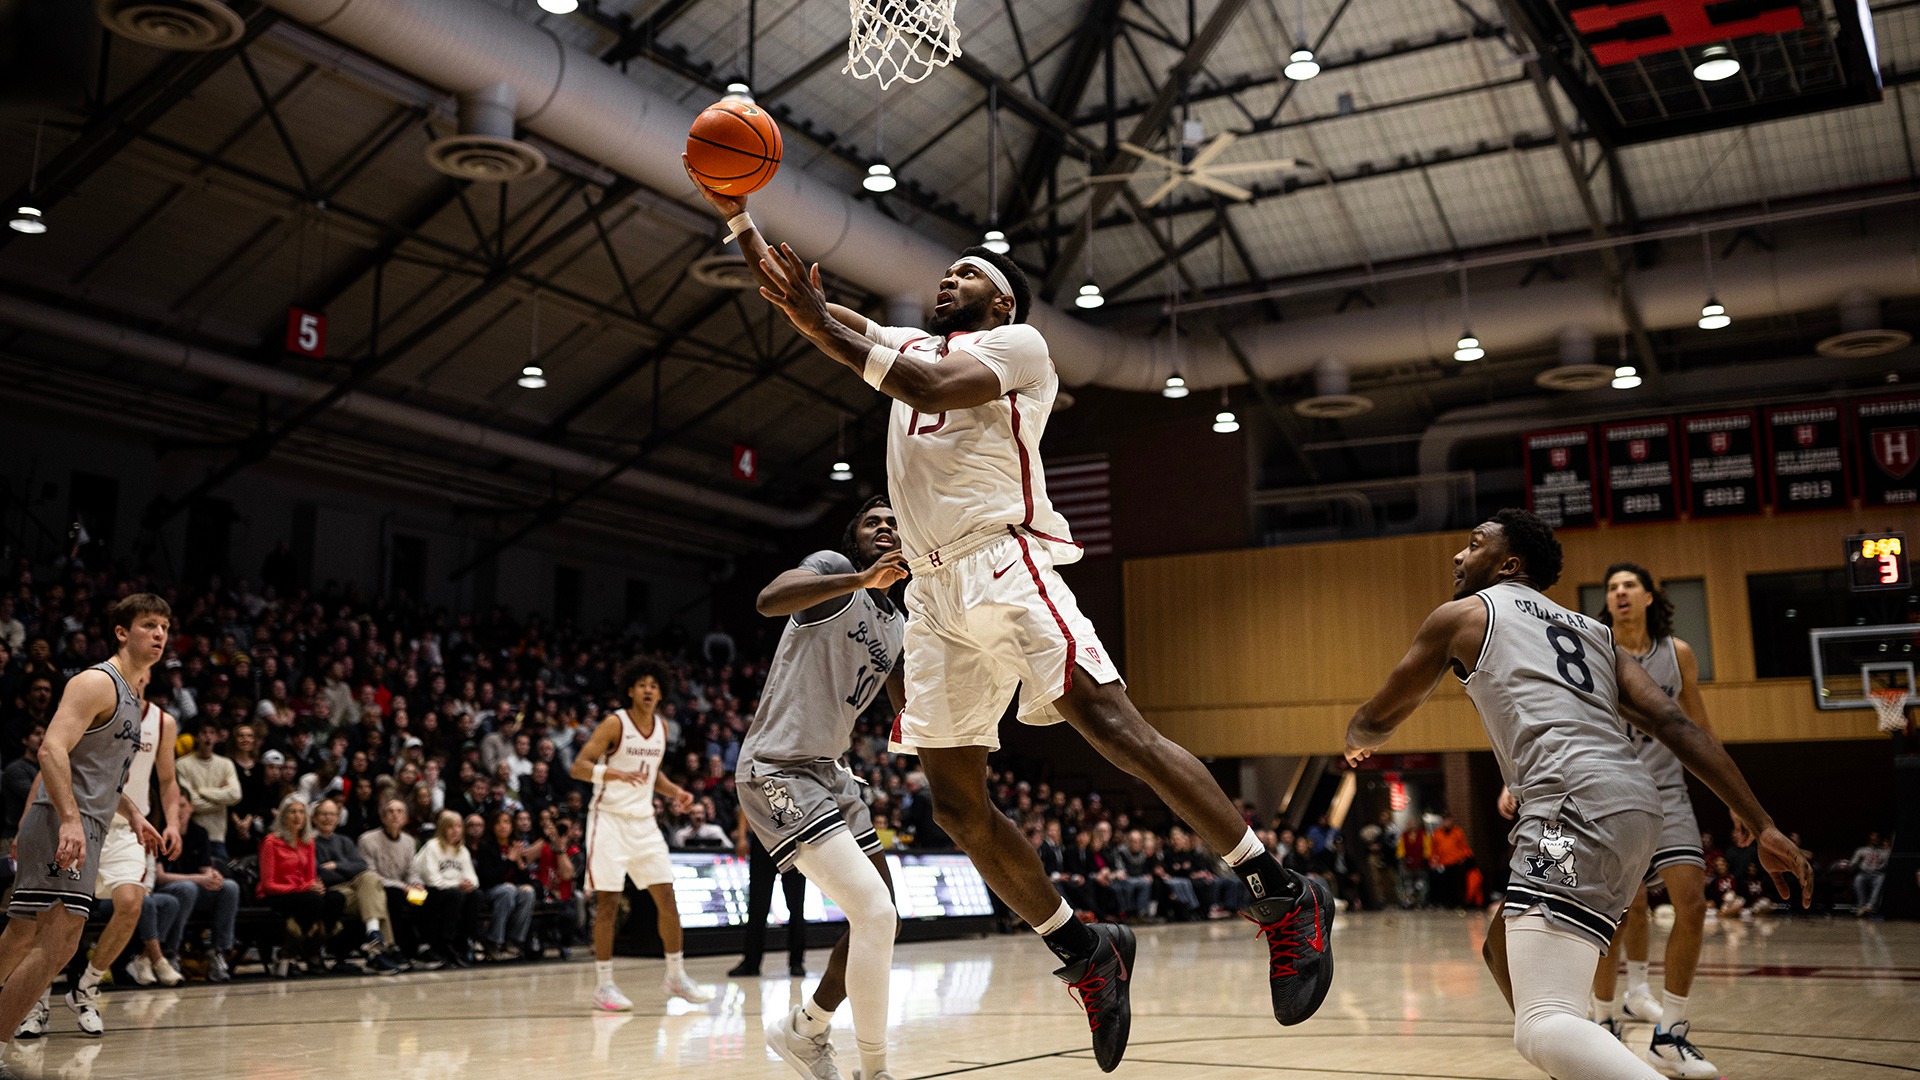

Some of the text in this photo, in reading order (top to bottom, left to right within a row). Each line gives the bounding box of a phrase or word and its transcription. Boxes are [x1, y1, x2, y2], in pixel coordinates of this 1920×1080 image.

[298, 313, 319, 352] 5
[1884, 432, 1910, 465] H
[738, 449, 754, 478] 4
[1623, 493, 1661, 513] 2011
[1703, 486, 1745, 507] 2012
[1789, 480, 1832, 500] 2013
[929, 551, 943, 567] H
[1878, 555, 1898, 583] 3
[1546, 625, 1595, 694] 8
[846, 665, 880, 710] 10
[1525, 856, 1556, 881] Y
